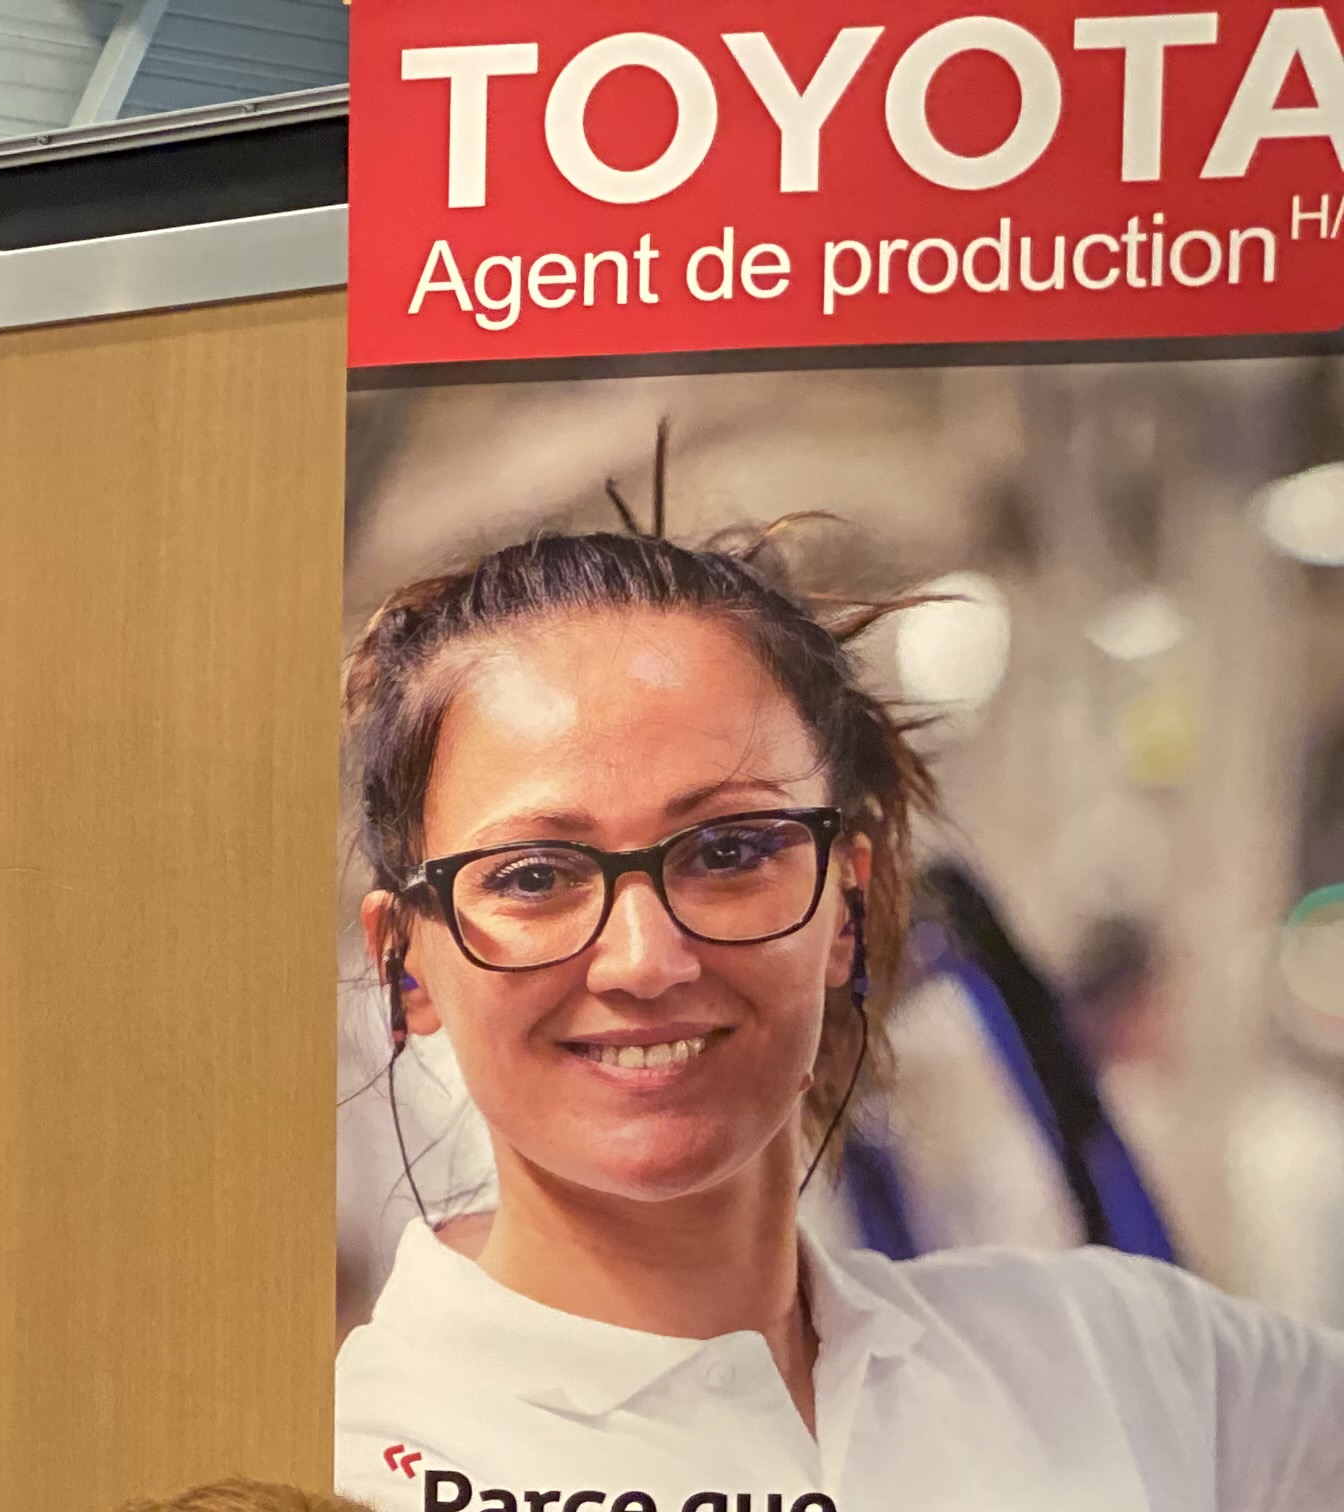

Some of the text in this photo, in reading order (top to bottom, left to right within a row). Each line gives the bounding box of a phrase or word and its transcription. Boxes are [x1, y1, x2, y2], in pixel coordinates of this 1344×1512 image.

[401, 8, 1344, 208] TOYOTA
[408, 234, 660, 330] Agent
[686, 228, 792, 300] de
[822, 213, 1277, 314] production
